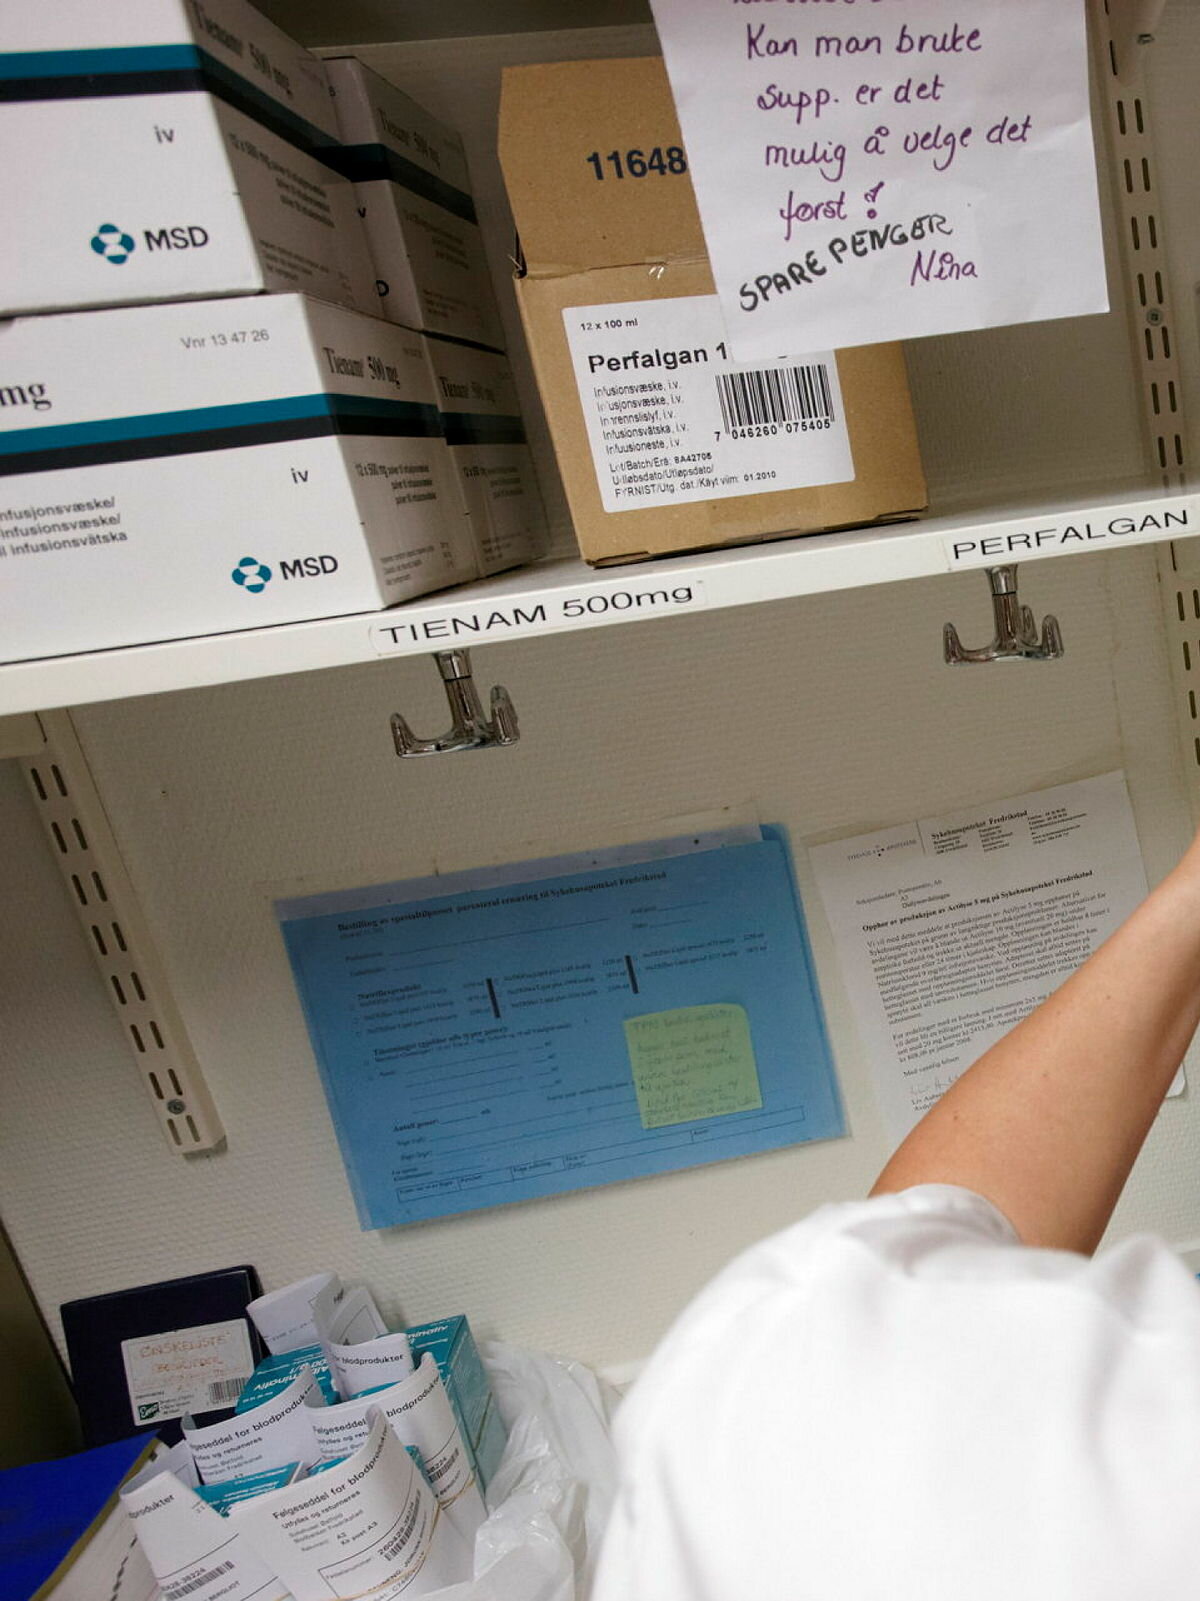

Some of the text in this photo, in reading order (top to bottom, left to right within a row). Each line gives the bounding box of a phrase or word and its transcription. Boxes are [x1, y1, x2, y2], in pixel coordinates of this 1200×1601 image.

[747, 23, 982, 60] Kan man bruke
[856, 84, 881, 105] er
[894, 74, 944, 103] det
[155, 125, 175, 142] iv
[765, 115, 1032, 182] mulig å velge det
[780, 190, 847, 241] først
[145, 227, 209, 252] MSD
[739, 214, 953, 311] SPARE PENGER
[581, 321, 593, 331] 12
[604, 319, 623, 329] 100
[625, 318, 638, 327] ml
[180, 329, 270, 350] Vnr 13 47 26
[587, 347, 709, 375] Perfalgan
[0, 383, 52, 411] mg
[714, 431, 720, 442] 7
[291, 468, 309, 484] iv
[952, 509, 1190, 561] PERFALGAN
[280, 555, 339, 580] MSD
[380, 582, 694, 647] TIENAM 500mg
[331, 1483, 347, 1496] for
